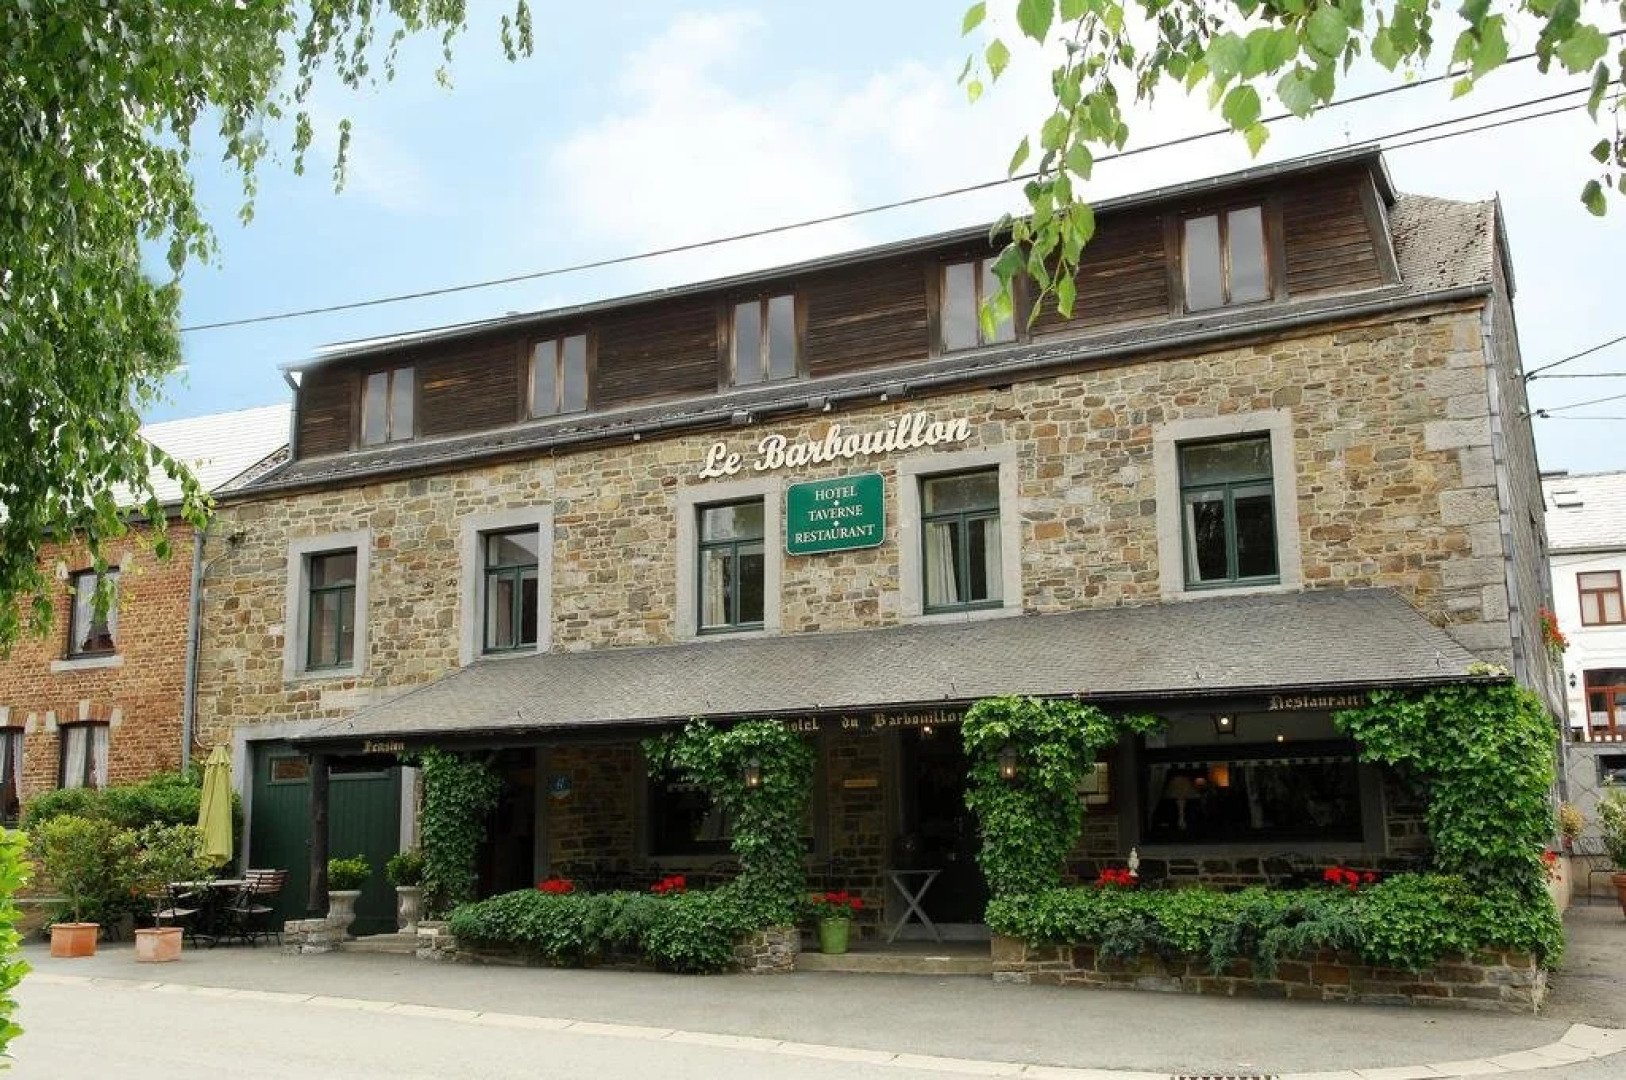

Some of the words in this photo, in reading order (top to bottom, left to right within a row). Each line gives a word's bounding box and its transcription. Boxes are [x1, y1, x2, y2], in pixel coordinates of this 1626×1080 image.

[699, 443, 741, 479] Le
[753, 411, 971, 471] Barbouillon
[815, 486, 857, 501] HOTEL
[808, 505, 863, 522] TAVERNE
[795, 524, 875, 544] RESTAURANT
[787, 717, 821, 732] otel
[842, 715, 859, 729] du
